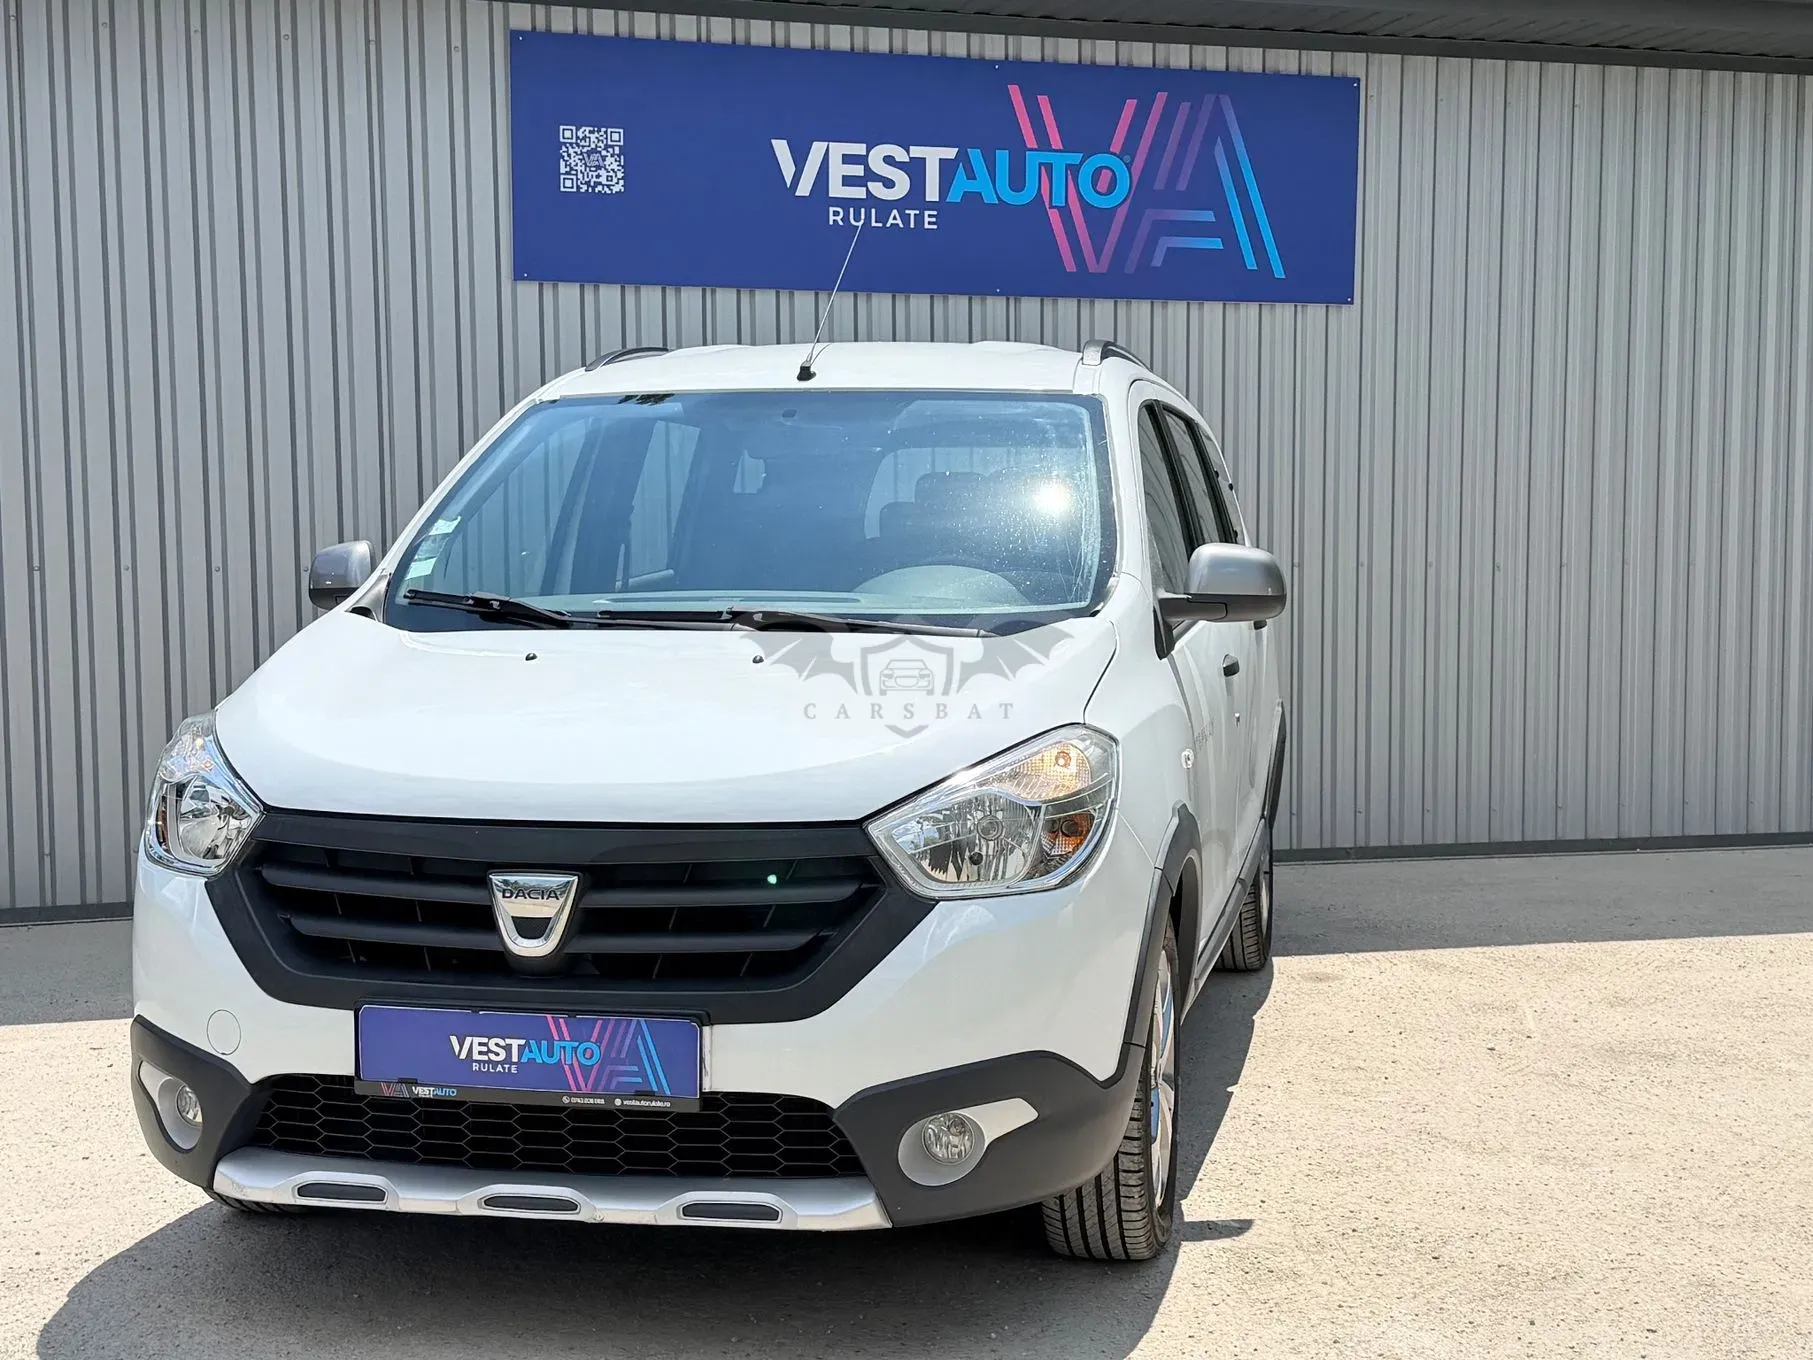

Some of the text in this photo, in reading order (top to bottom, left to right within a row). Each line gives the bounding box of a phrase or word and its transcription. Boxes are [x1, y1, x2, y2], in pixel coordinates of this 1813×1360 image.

[828, 207, 939, 230] RULATE
[502, 888, 560, 901] DACIA
[472, 1062, 518, 1074] RULATE
